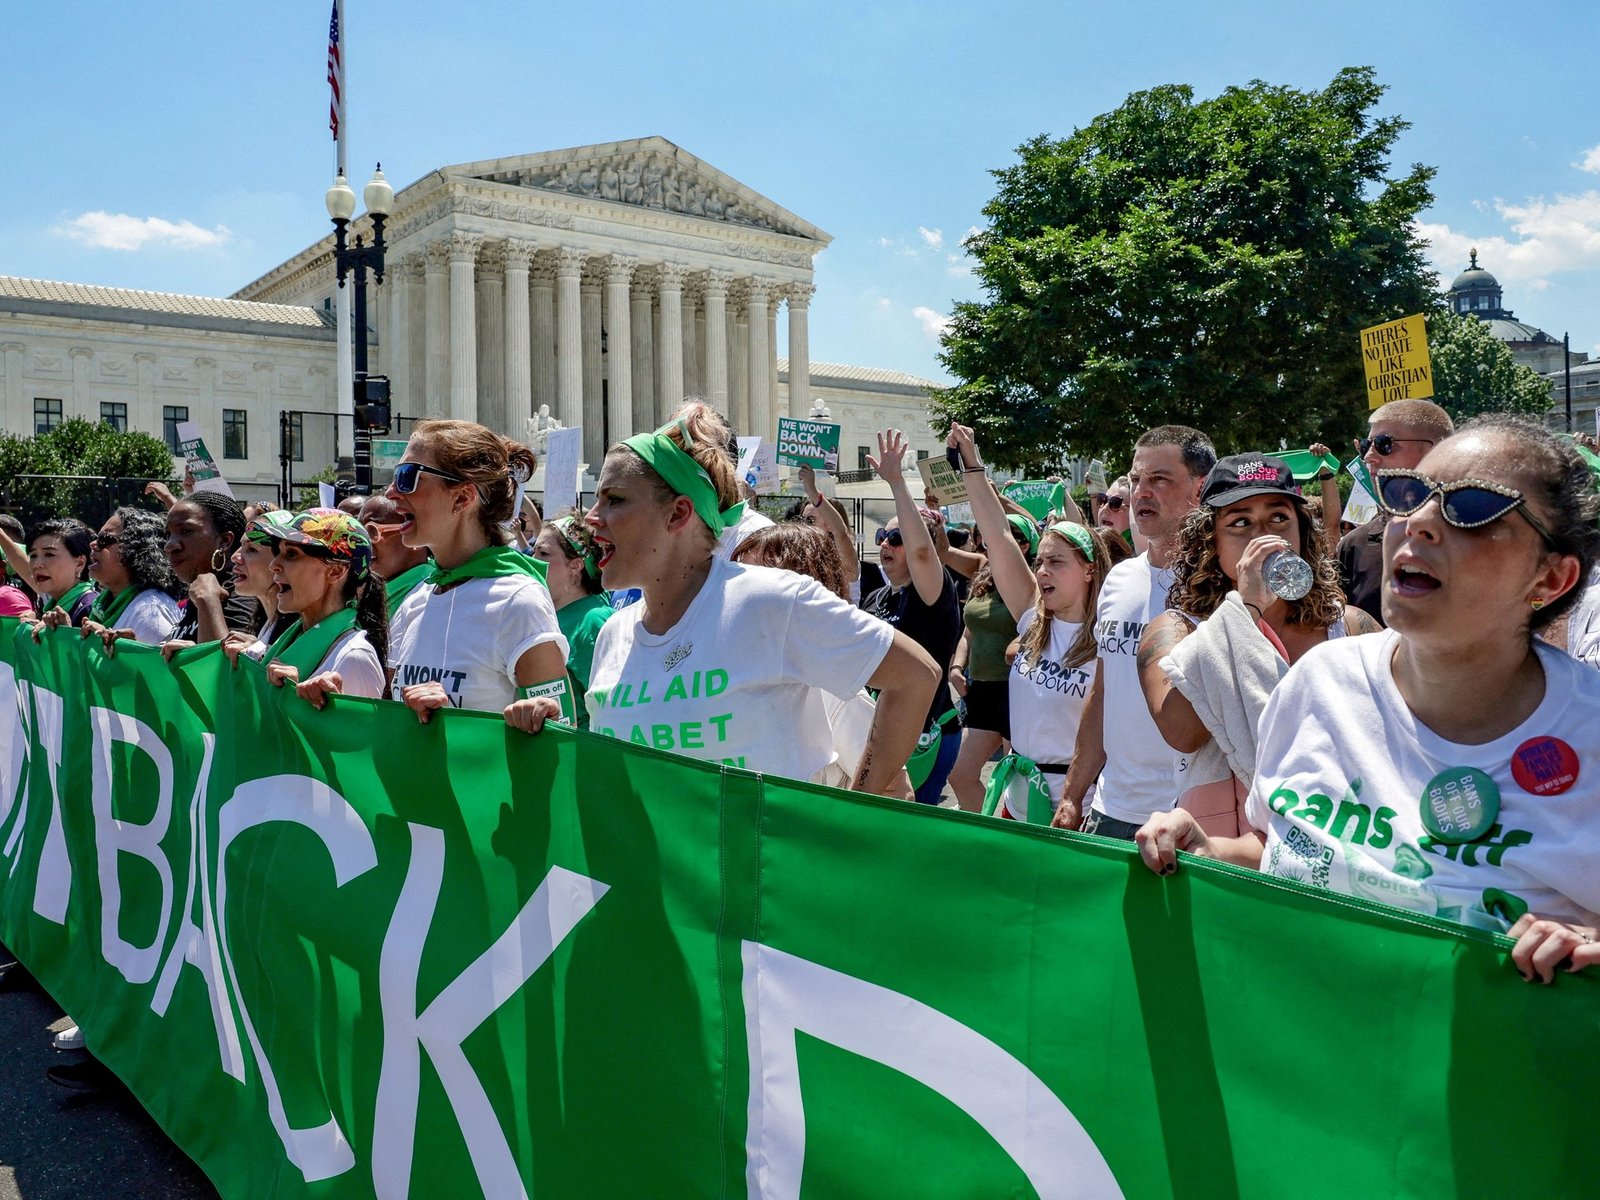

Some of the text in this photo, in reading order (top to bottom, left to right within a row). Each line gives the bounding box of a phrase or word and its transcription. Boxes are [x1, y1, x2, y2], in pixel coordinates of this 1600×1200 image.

[1364, 321, 1408, 346] THERE'S
[1365, 337, 1413, 361] NO HATE
[1379, 354, 1406, 373] LIKE
[1369, 365, 1428, 391] CHRISTIAN
[1383, 384, 1412, 402] LOVE
[780, 429, 817, 445] BACK
[781, 420, 832, 434] WE WON'T
[778, 441, 825, 457] DOWN.
[1237, 460, 1264, 470] BANS
[1237, 467, 1257, 476] OFF
[1239, 473, 1277, 481] BODIES
[1100, 637, 1129, 655] ACK
[403, 664, 467, 693] WON'T
[529, 682, 563, 697] bans off
[663, 668, 729, 702] AID
[1013, 660, 1087, 699] ACK DOWN
[629, 713, 733, 751] ABET
[1460, 775, 1482, 809] BANS
[1267, 778, 1399, 849] bans
[1429, 787, 1454, 833] BODIES
[1444, 781, 1471, 832] OFF OUR
[90, 706, 611, 1200] BACK
